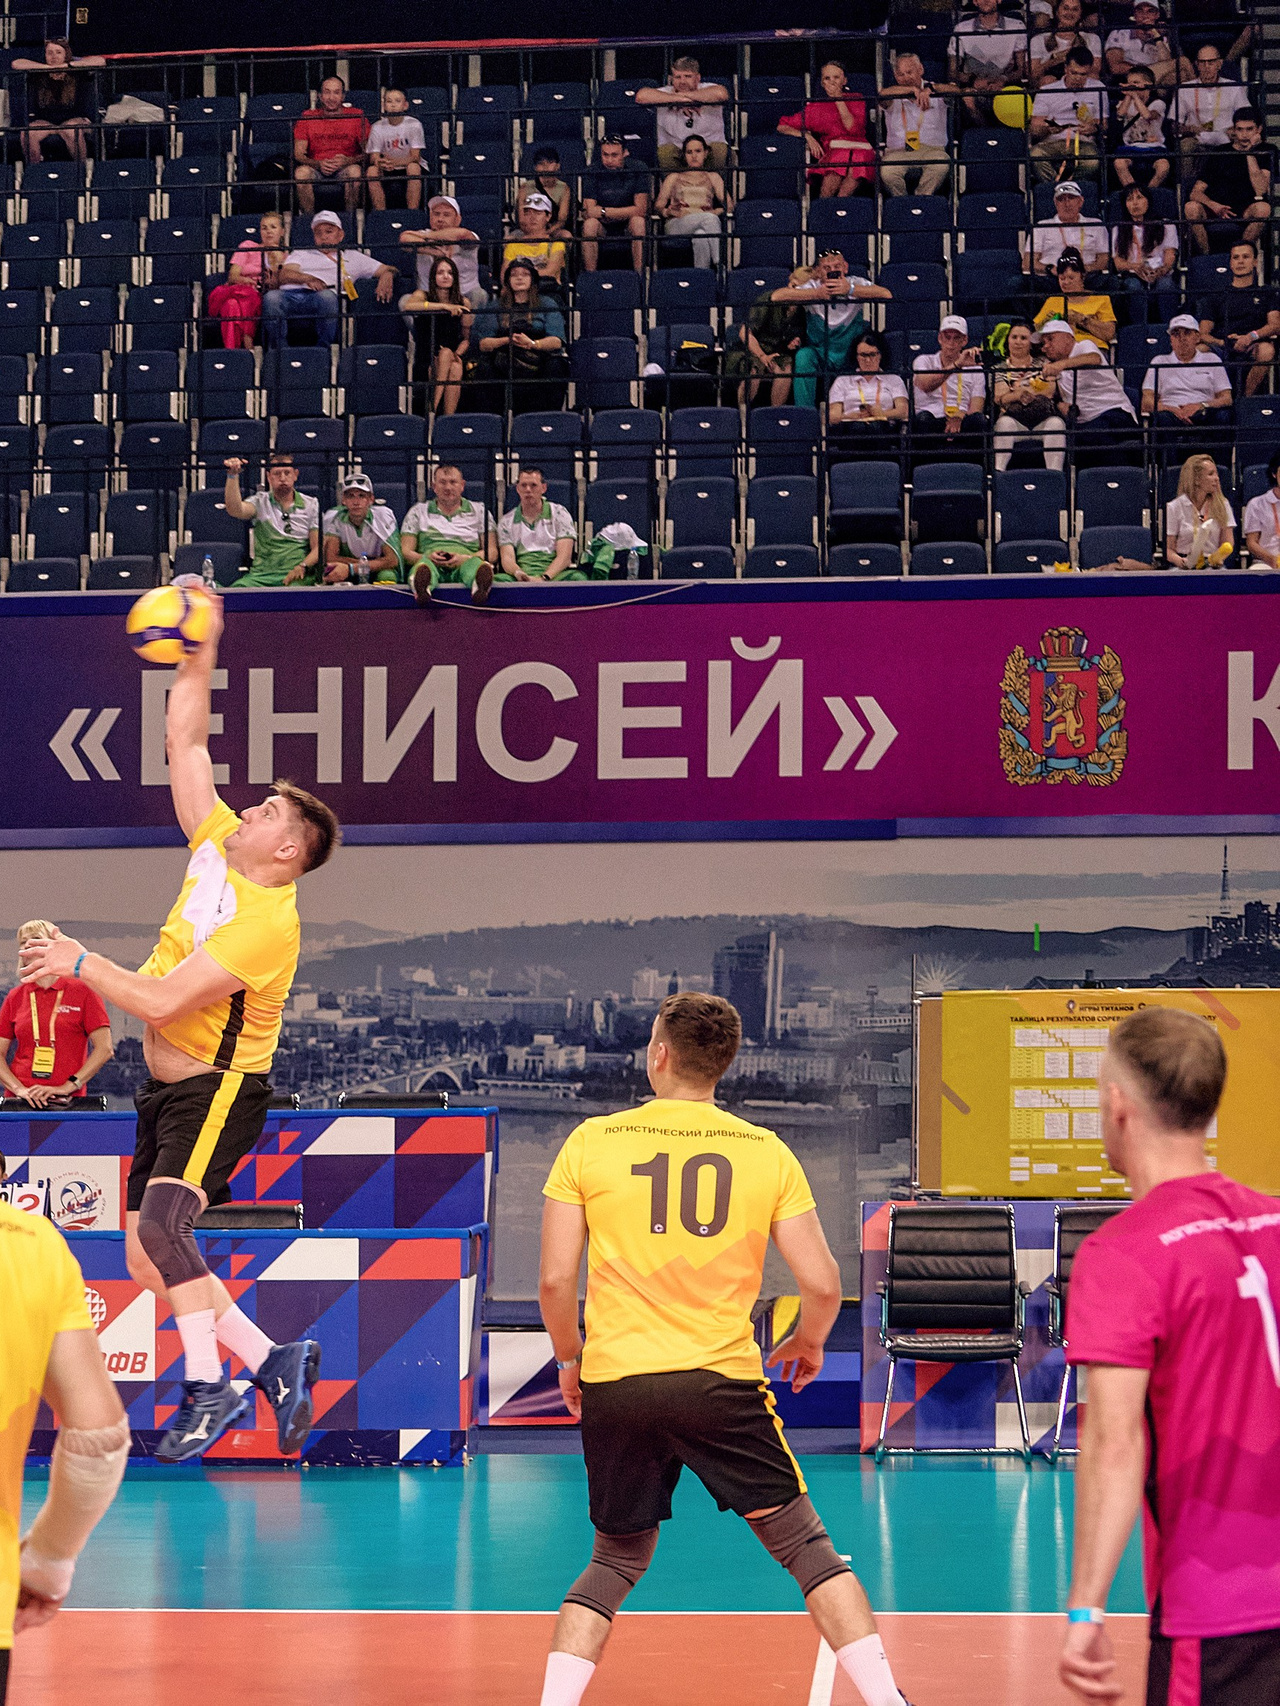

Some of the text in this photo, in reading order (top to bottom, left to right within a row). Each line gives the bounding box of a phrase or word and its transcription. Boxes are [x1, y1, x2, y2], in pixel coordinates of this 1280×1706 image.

[605, 1125, 765, 1142] ЛОГИСТИЧЕСКИЙ ДИВИЗИОН
[631, 1152, 733, 1238] 10
[101, 1351, 148, 1374] ФВ
